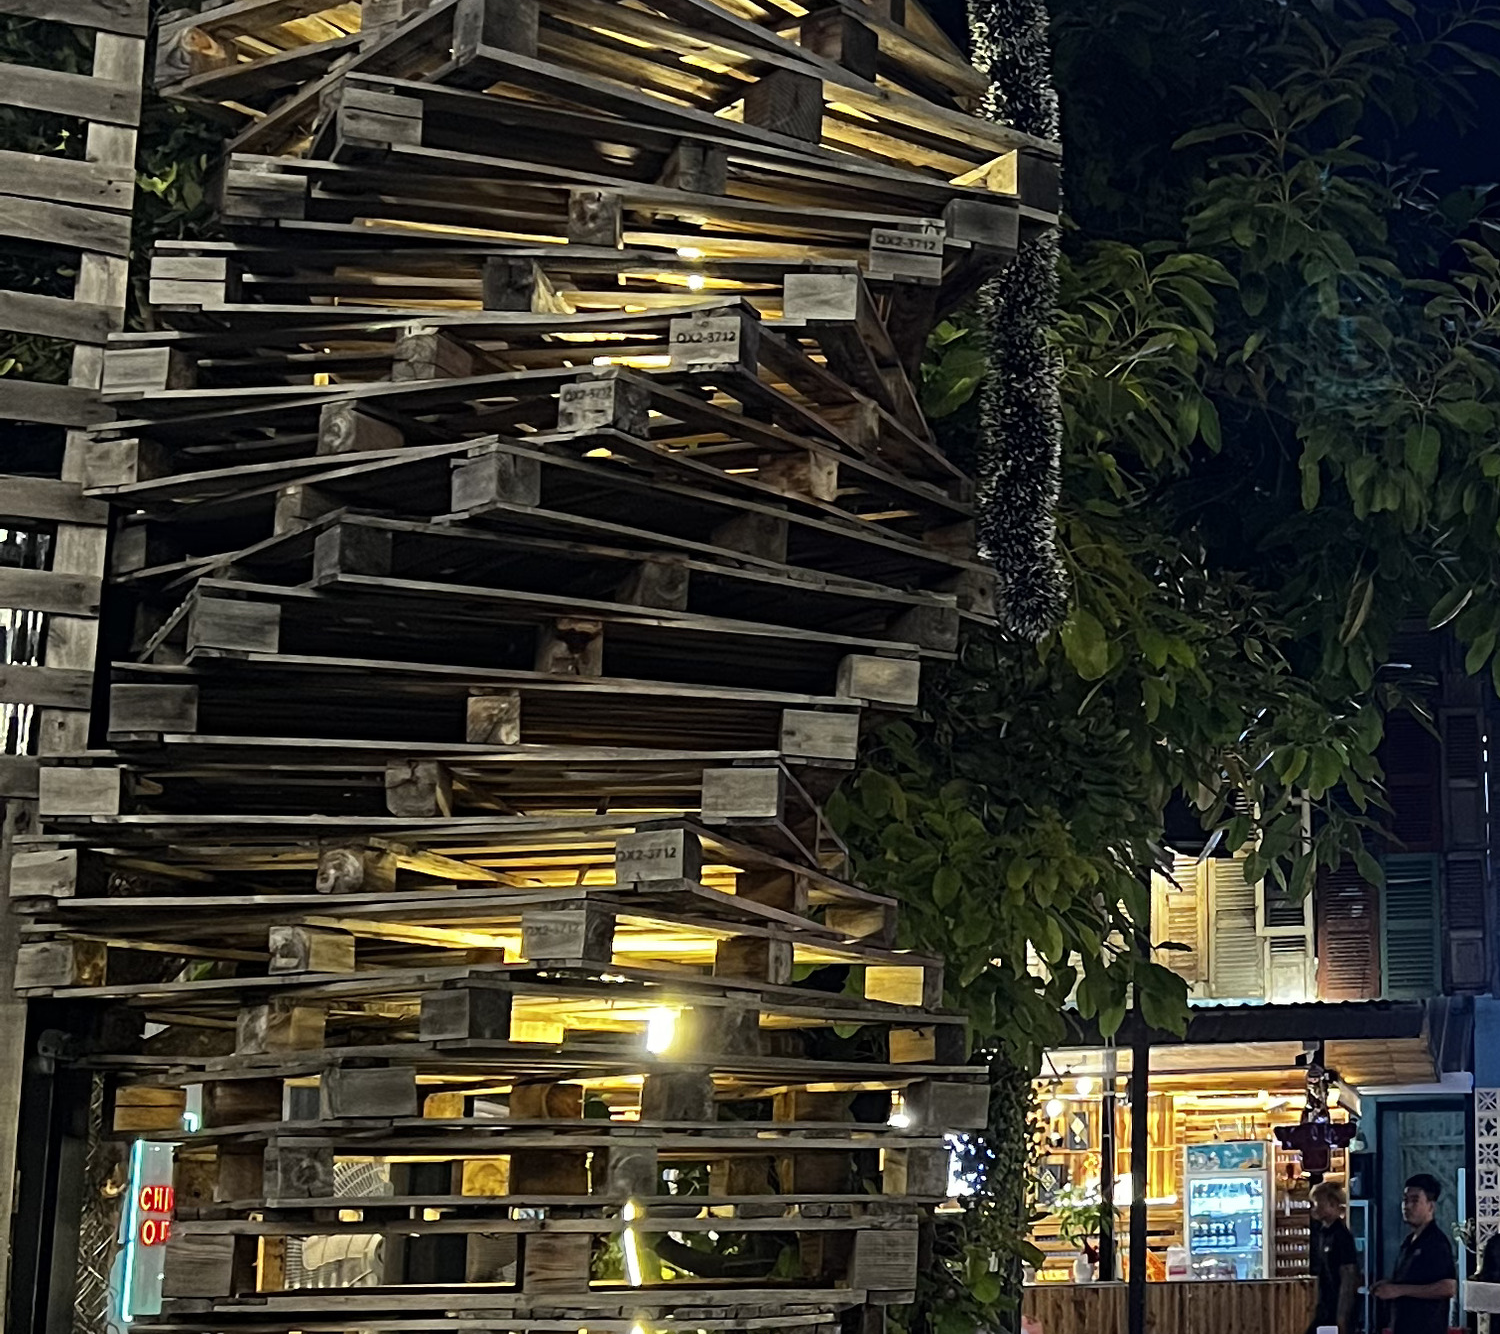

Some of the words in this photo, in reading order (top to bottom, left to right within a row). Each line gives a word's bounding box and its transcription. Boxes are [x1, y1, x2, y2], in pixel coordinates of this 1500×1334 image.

[875, 234, 936, 251] QX2-3712
[676, 331, 736, 344] QX2-3712
[617, 847, 676, 862] QX2-3712
[140, 1186, 174, 1212] CHI
